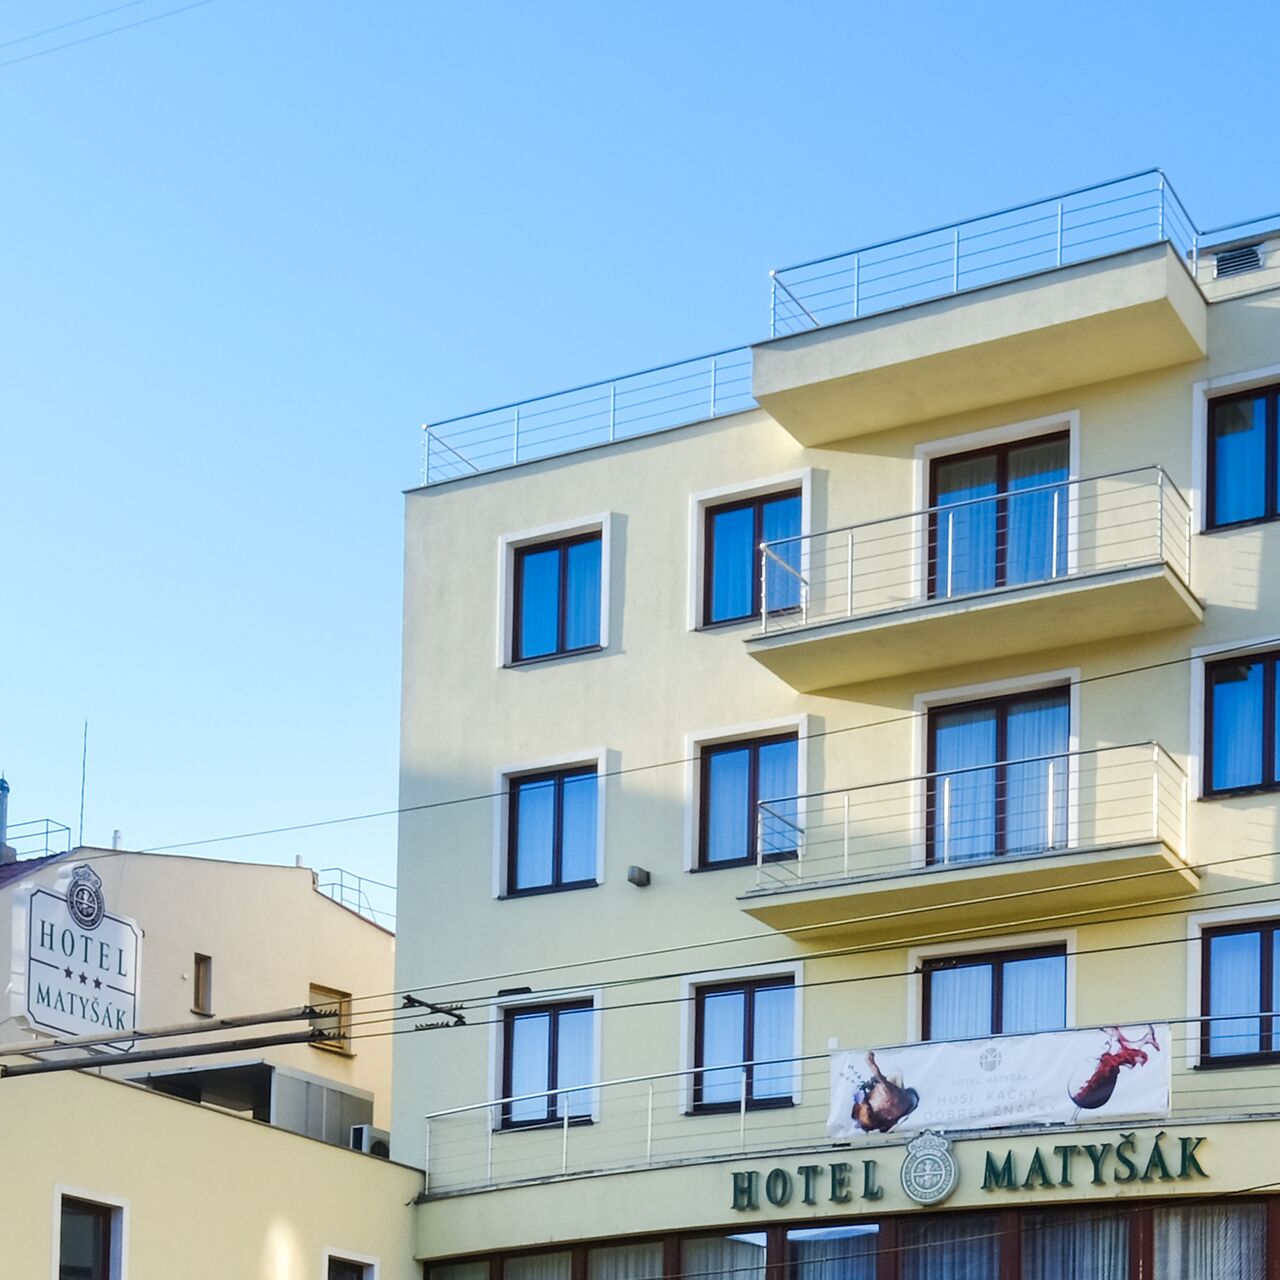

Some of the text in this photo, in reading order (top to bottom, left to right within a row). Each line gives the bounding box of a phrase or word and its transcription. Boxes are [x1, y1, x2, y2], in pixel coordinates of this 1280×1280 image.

[40, 919, 127, 977] HOTEL
[36, 982, 126, 1031] MATYŠÁK
[731, 1159, 883, 1211] HOTEL
[980, 1131, 1210, 1190] MATYŠÁK
